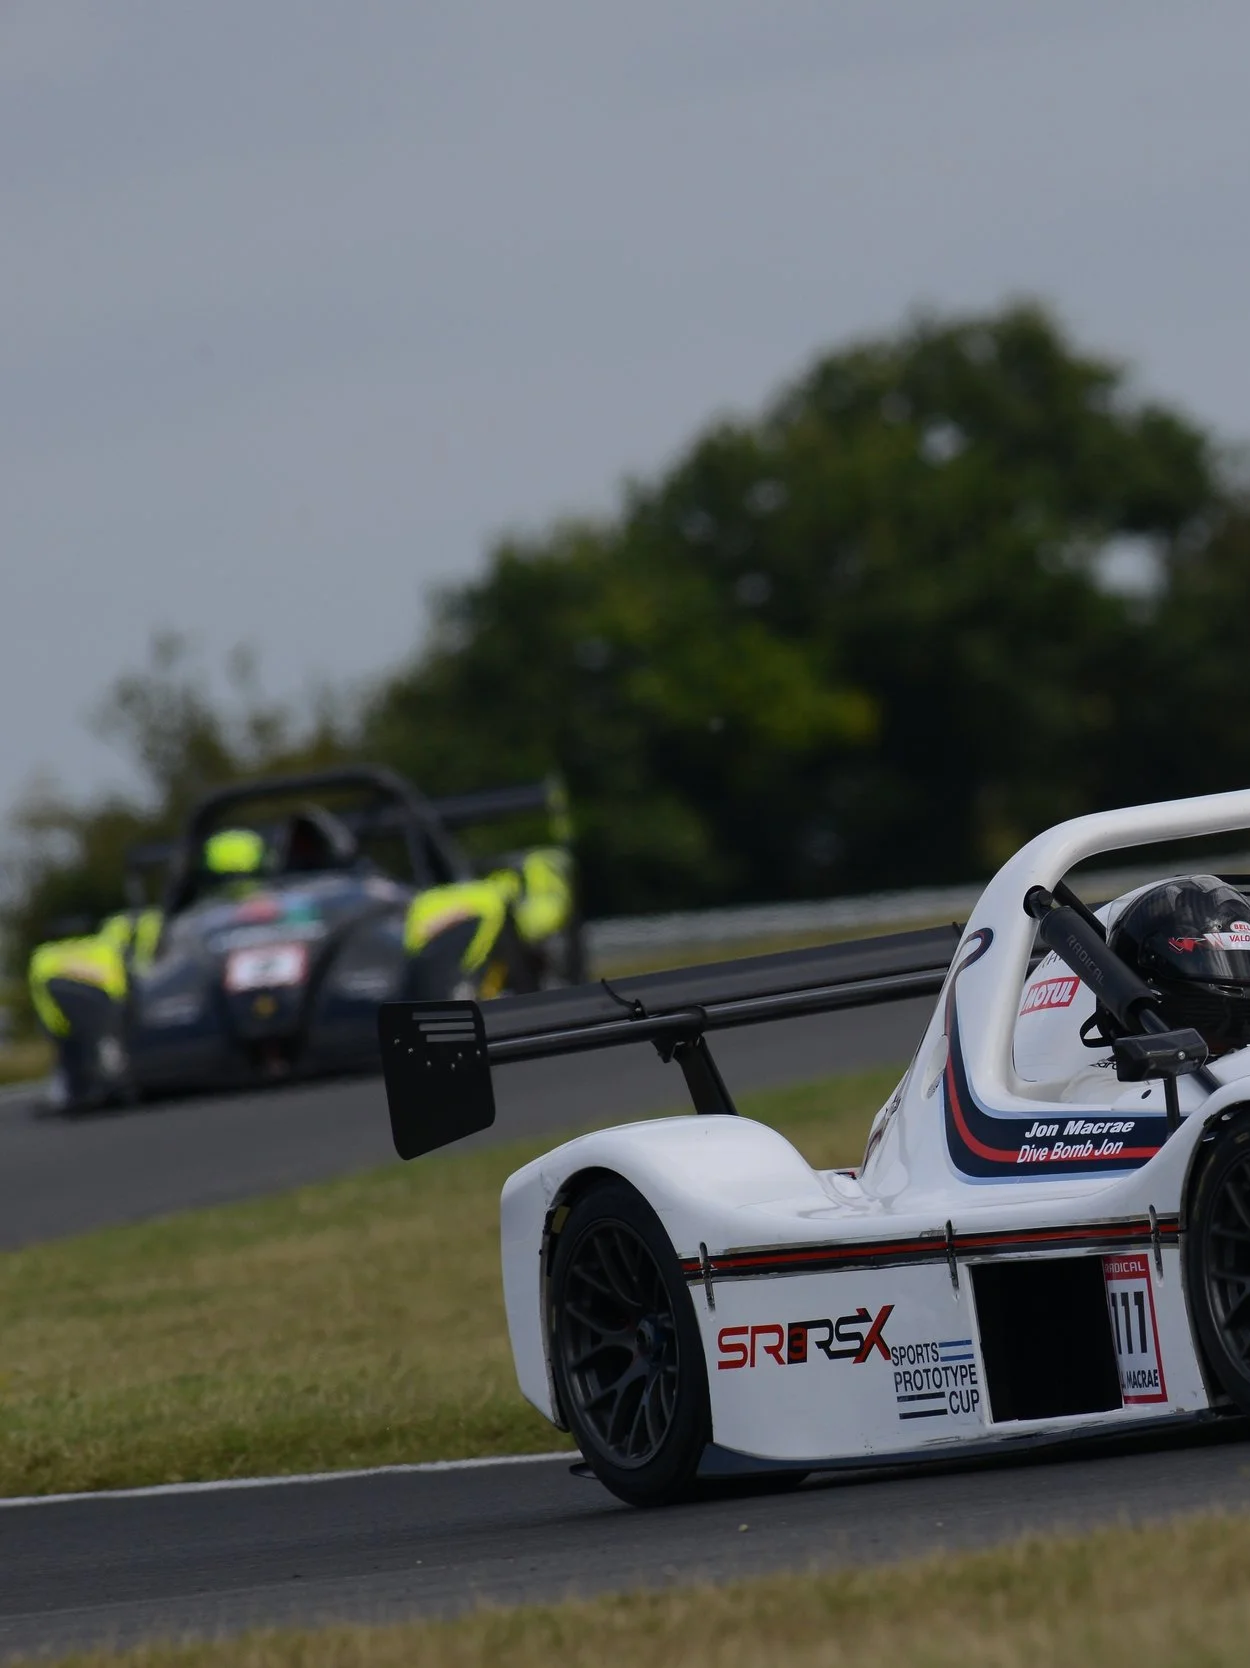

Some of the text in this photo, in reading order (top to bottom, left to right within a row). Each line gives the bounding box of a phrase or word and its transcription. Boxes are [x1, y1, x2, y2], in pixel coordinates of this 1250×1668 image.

[1233, 923, 1250, 931] BELL
[1066, 934, 1104, 985] RADICAL
[1023, 980, 1074, 1011] MOTUL
[1025, 1120, 1135, 1138] Jon Macrae
[1017, 1138, 1124, 1163] Dive Bomb Jon
[1111, 1291, 1147, 1355] 111
[891, 1342, 940, 1367] SPORTS
[894, 1364, 978, 1392] PROTOTYPE
[1126, 1369, 1159, 1389] MACRAE
[948, 1389, 980, 1415] CUP
